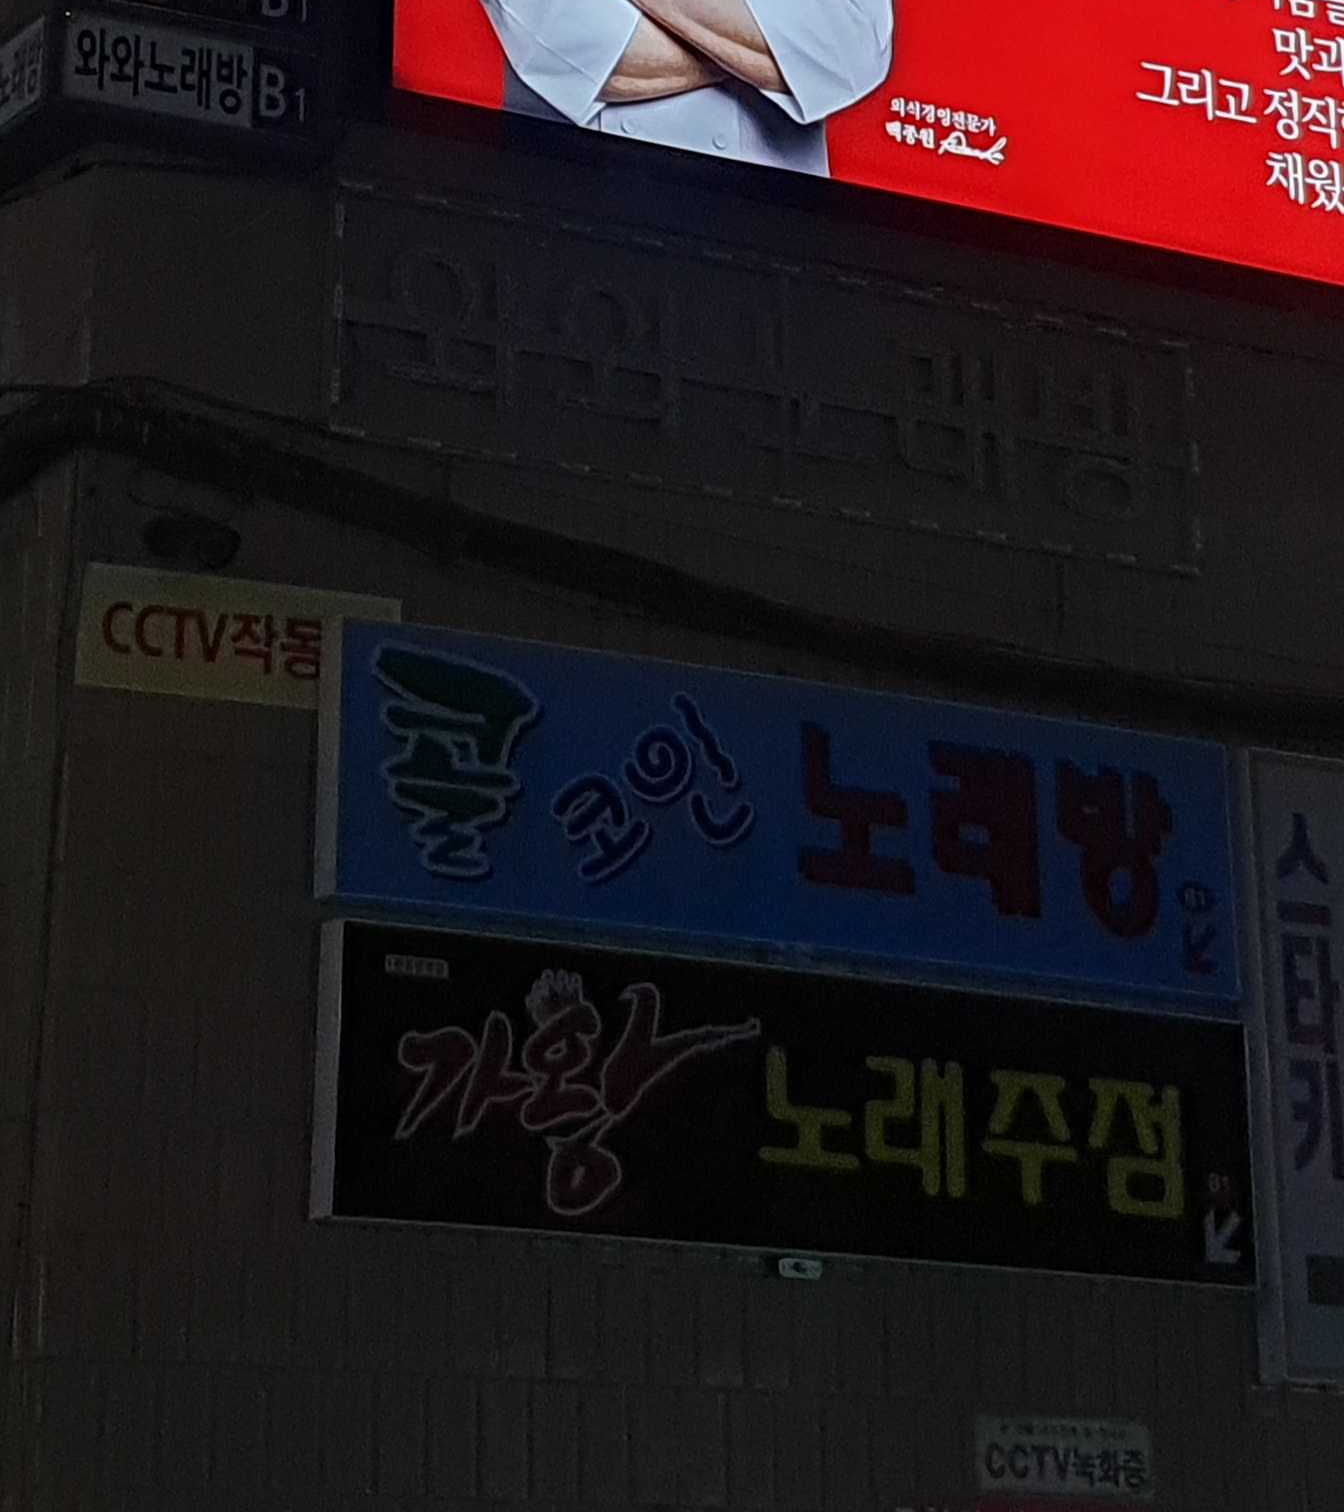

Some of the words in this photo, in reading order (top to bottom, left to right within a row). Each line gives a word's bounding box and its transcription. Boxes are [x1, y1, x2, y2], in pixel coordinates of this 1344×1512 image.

[74, 28, 252, 114] 와와노래방
[257, 64, 307, 122] B1
[1136, 61, 1257, 124] 그리고
[102, 601, 322, 680] CCTV작동
[798, 721, 1174, 940] 노래방
[757, 1044, 1187, 1220] 노래주점
